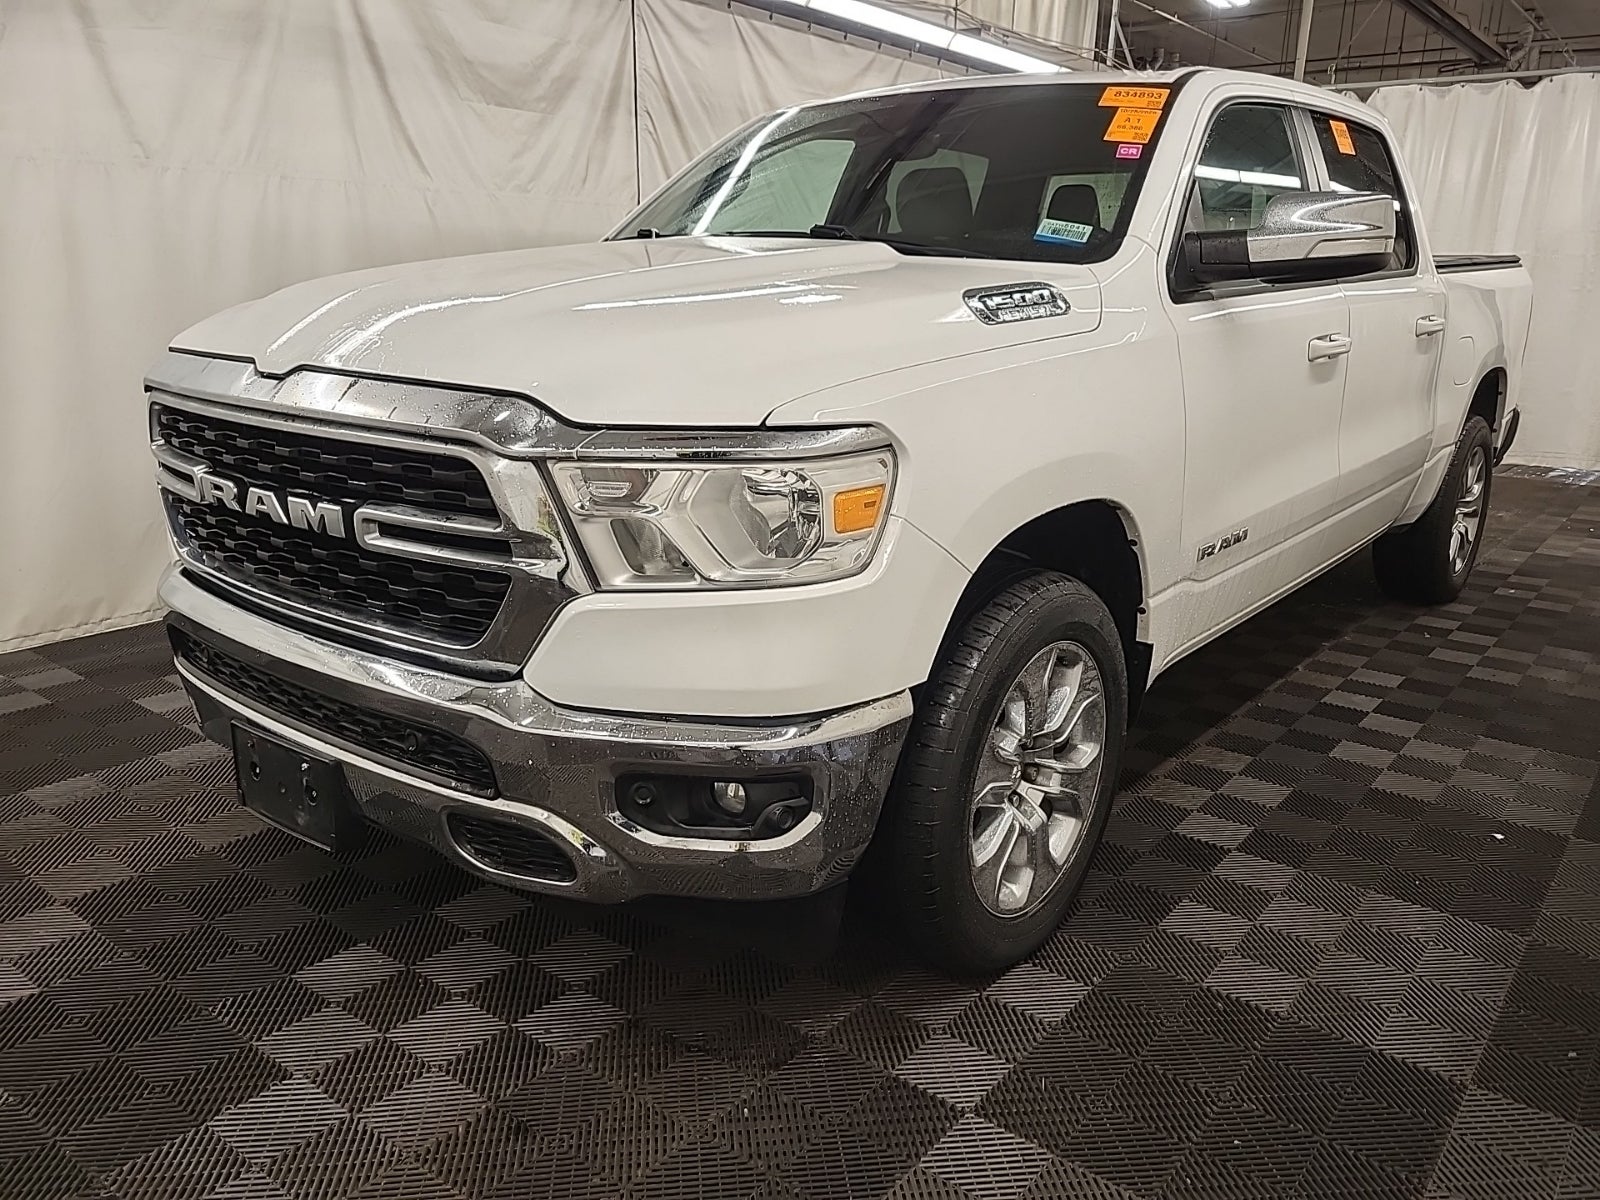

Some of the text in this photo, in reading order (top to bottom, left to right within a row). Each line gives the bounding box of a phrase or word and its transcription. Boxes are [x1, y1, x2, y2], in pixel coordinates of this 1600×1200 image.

[1113, 90, 1163, 100] 834893
[1120, 147, 1138, 155] CR
[979, 288, 1053, 310] 1500
[200, 472, 346, 539] RAM
[1196, 526, 1249, 563] RAM
